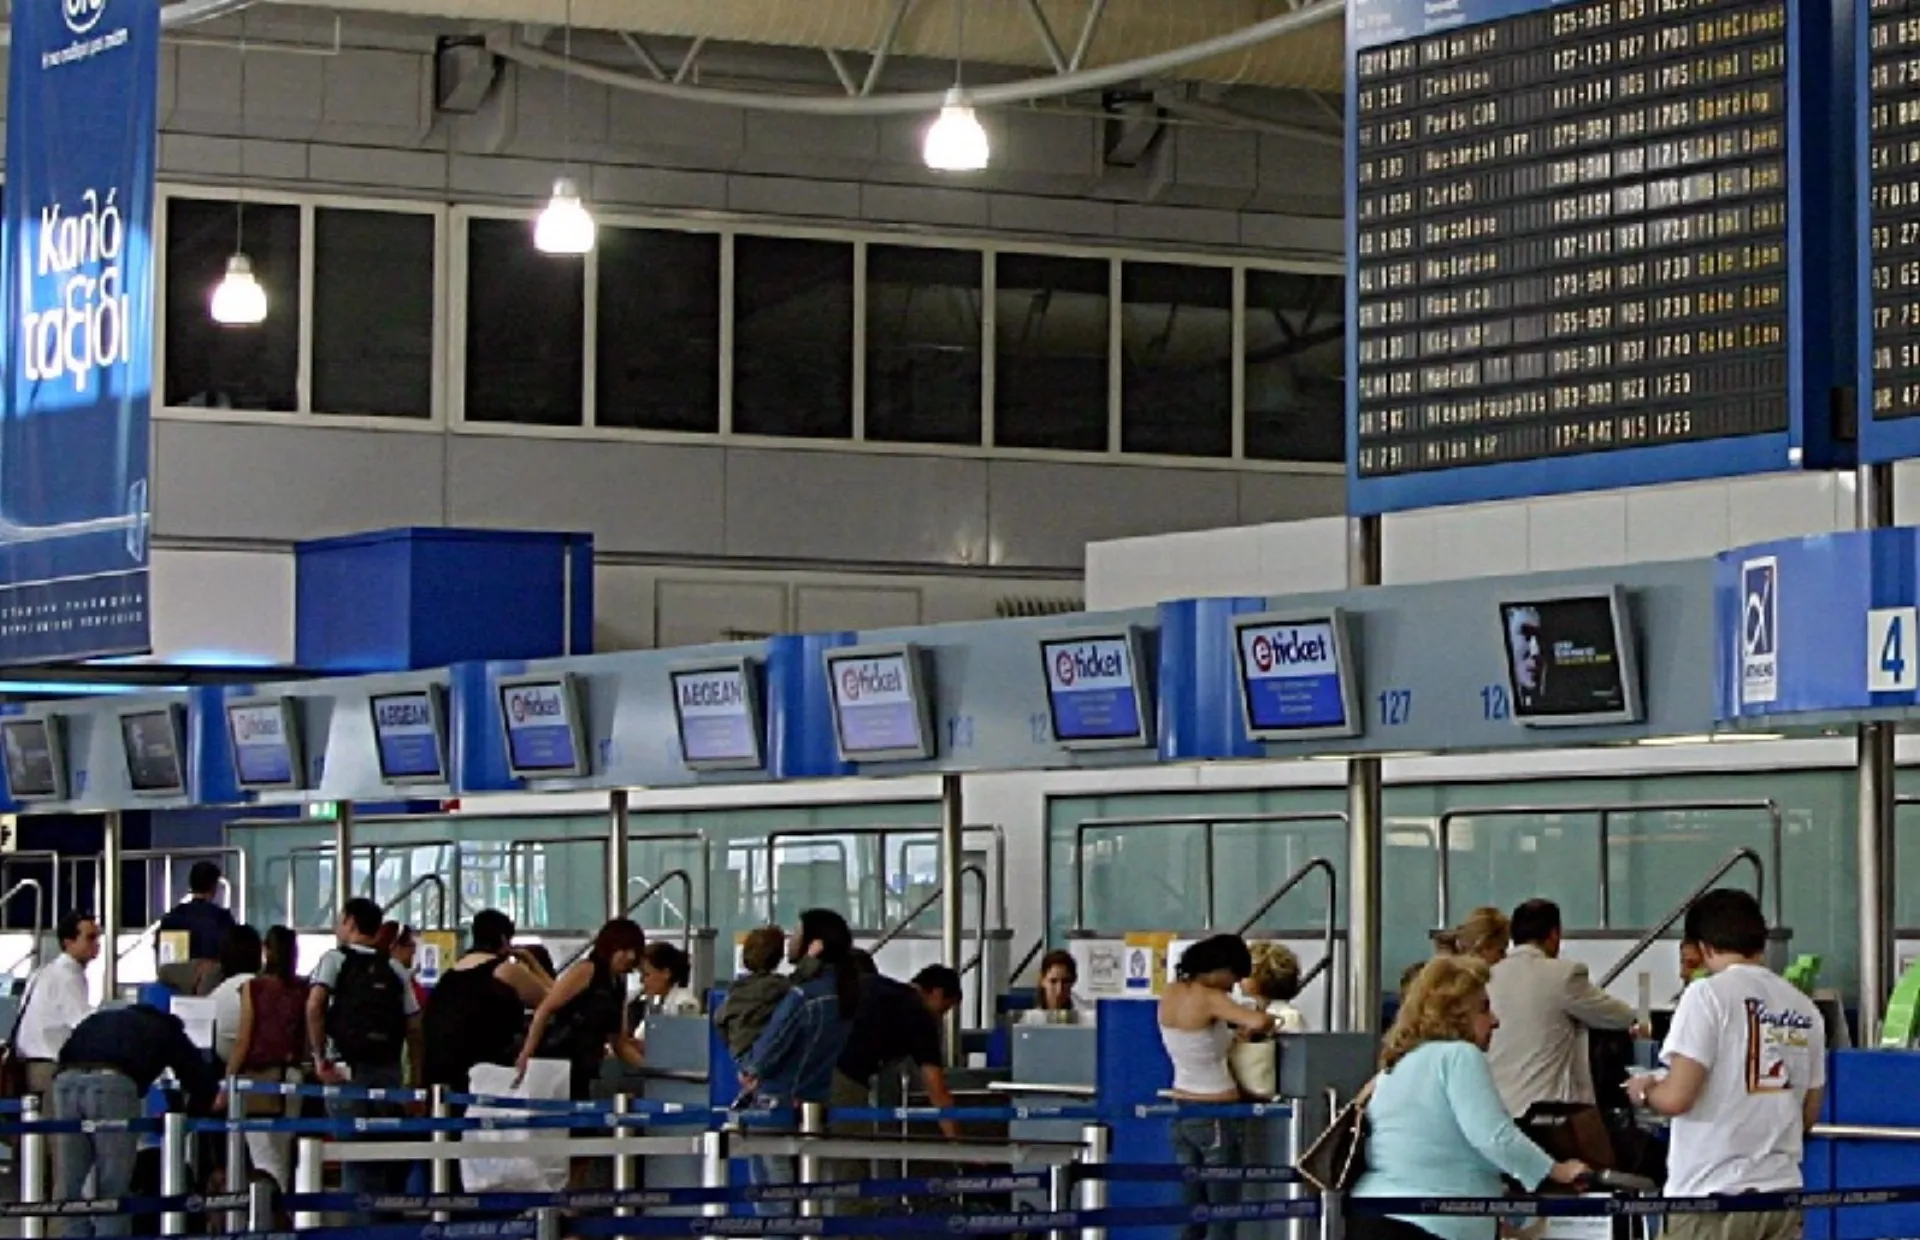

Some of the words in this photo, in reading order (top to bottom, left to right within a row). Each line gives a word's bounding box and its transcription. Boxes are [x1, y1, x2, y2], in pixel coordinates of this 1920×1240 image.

[38, 186, 121, 275] Καλό
[22, 266, 130, 392] ταξίδι
[1881, 616, 1905, 683] 4
[1378, 690, 1411, 725] 127
[1481, 684, 1509, 721] 12
